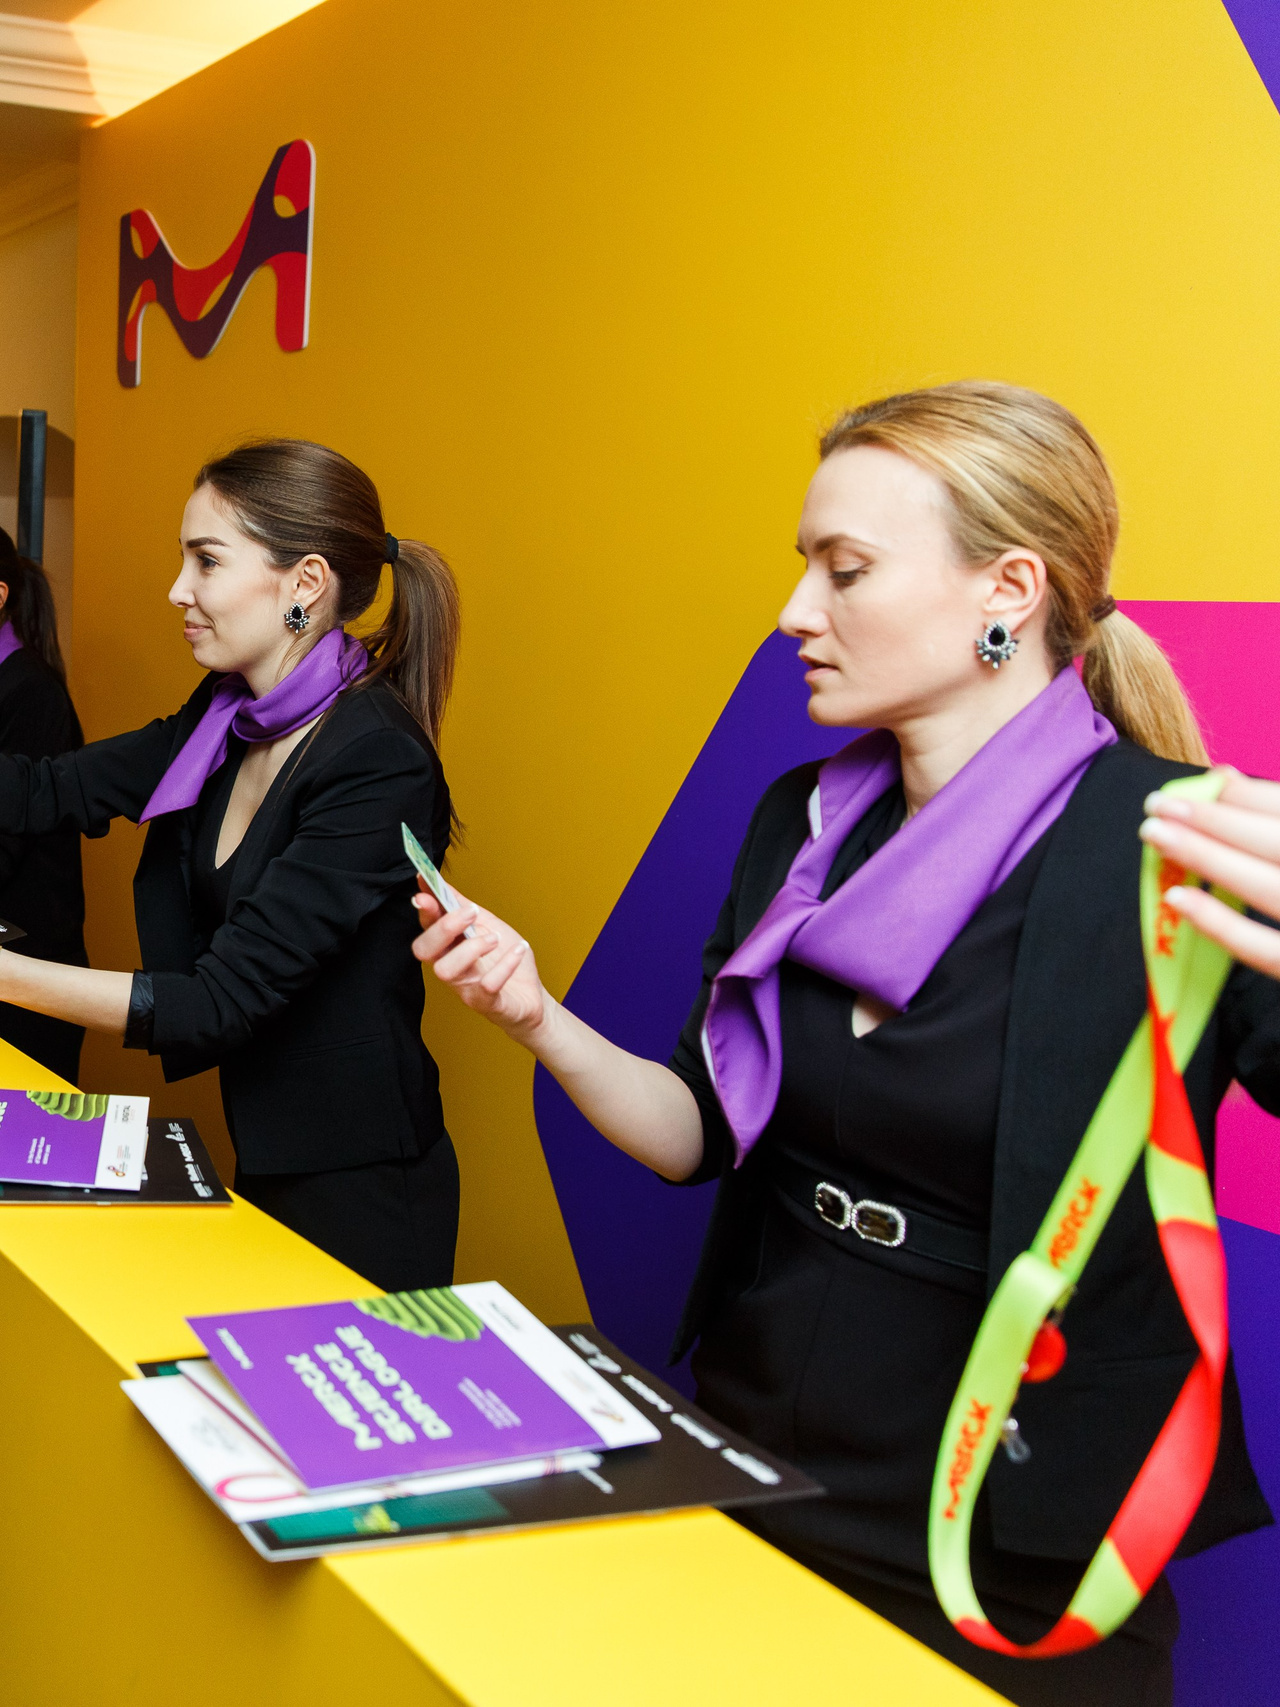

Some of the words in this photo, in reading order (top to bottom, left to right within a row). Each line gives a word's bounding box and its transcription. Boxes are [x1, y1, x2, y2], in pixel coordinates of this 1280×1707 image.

[285, 1352, 383, 1451] MERCK
[313, 1341, 417, 1445] SCIENCE
[334, 1324, 453, 1440] DIALOGUE
[943, 1396, 994, 1522] MERCK
